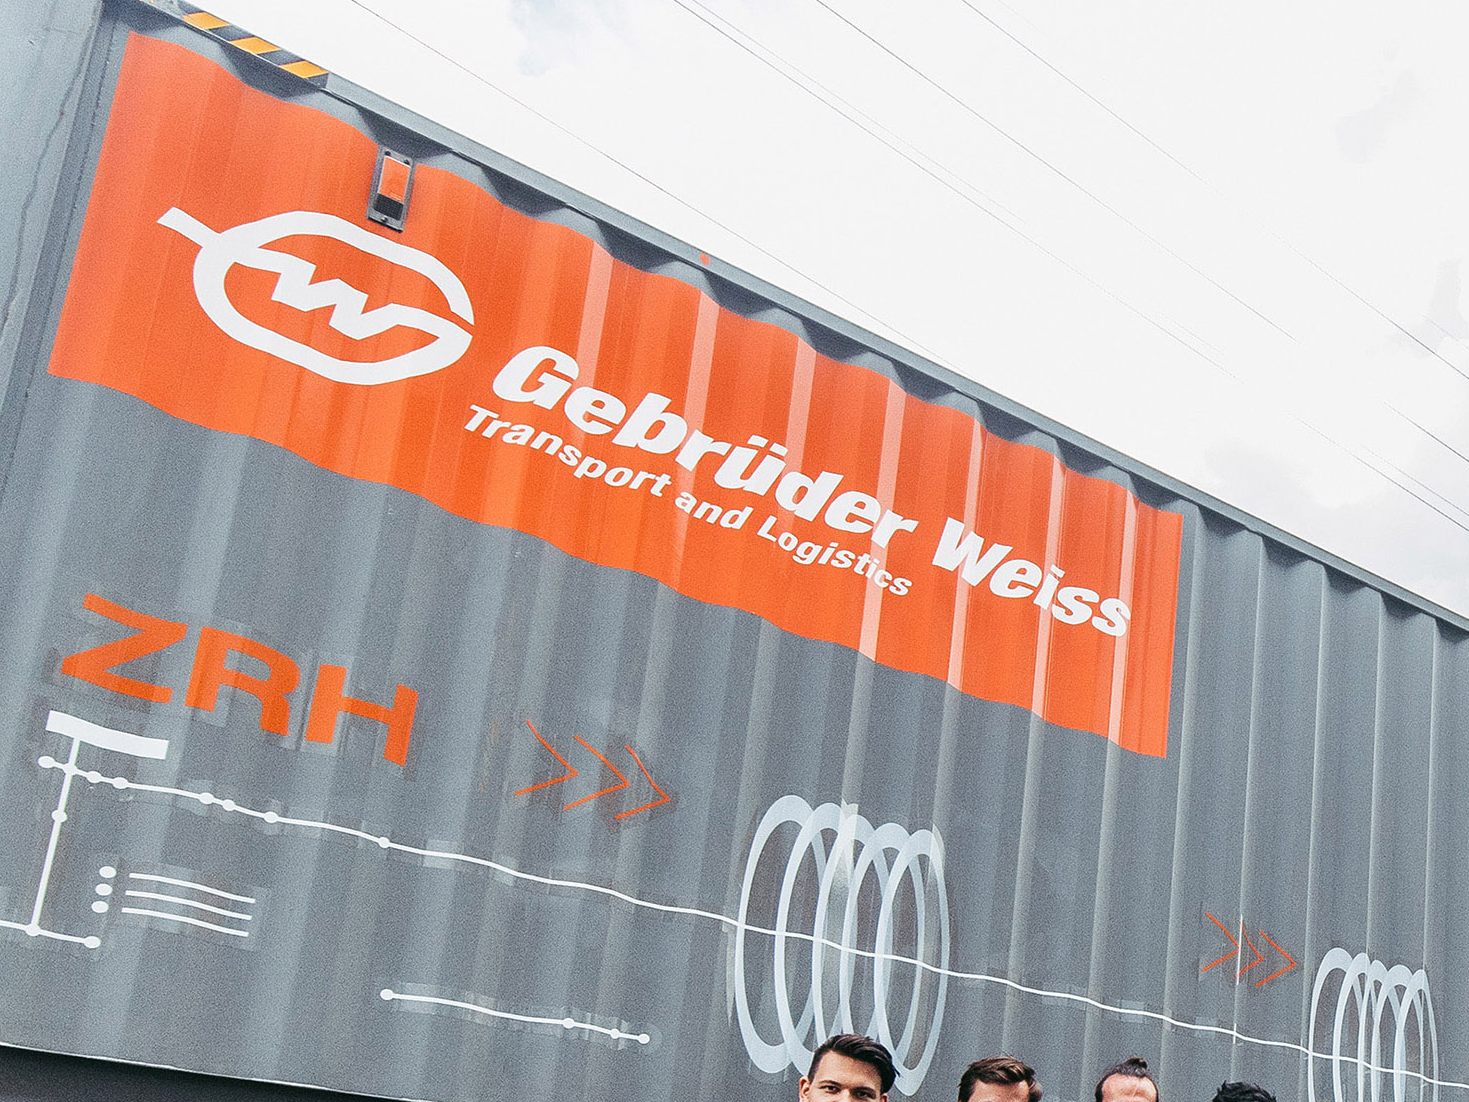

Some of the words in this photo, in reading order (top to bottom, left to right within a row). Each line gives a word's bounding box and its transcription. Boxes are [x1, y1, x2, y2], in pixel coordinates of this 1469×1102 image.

[463, 405, 673, 498] Transport
[675, 486, 752, 533] and
[757, 515, 913, 597] Logistics
[491, 345, 918, 550] Gebrüder
[931, 515, 1132, 638] Weiss
[60, 593, 419, 766] ZRH
